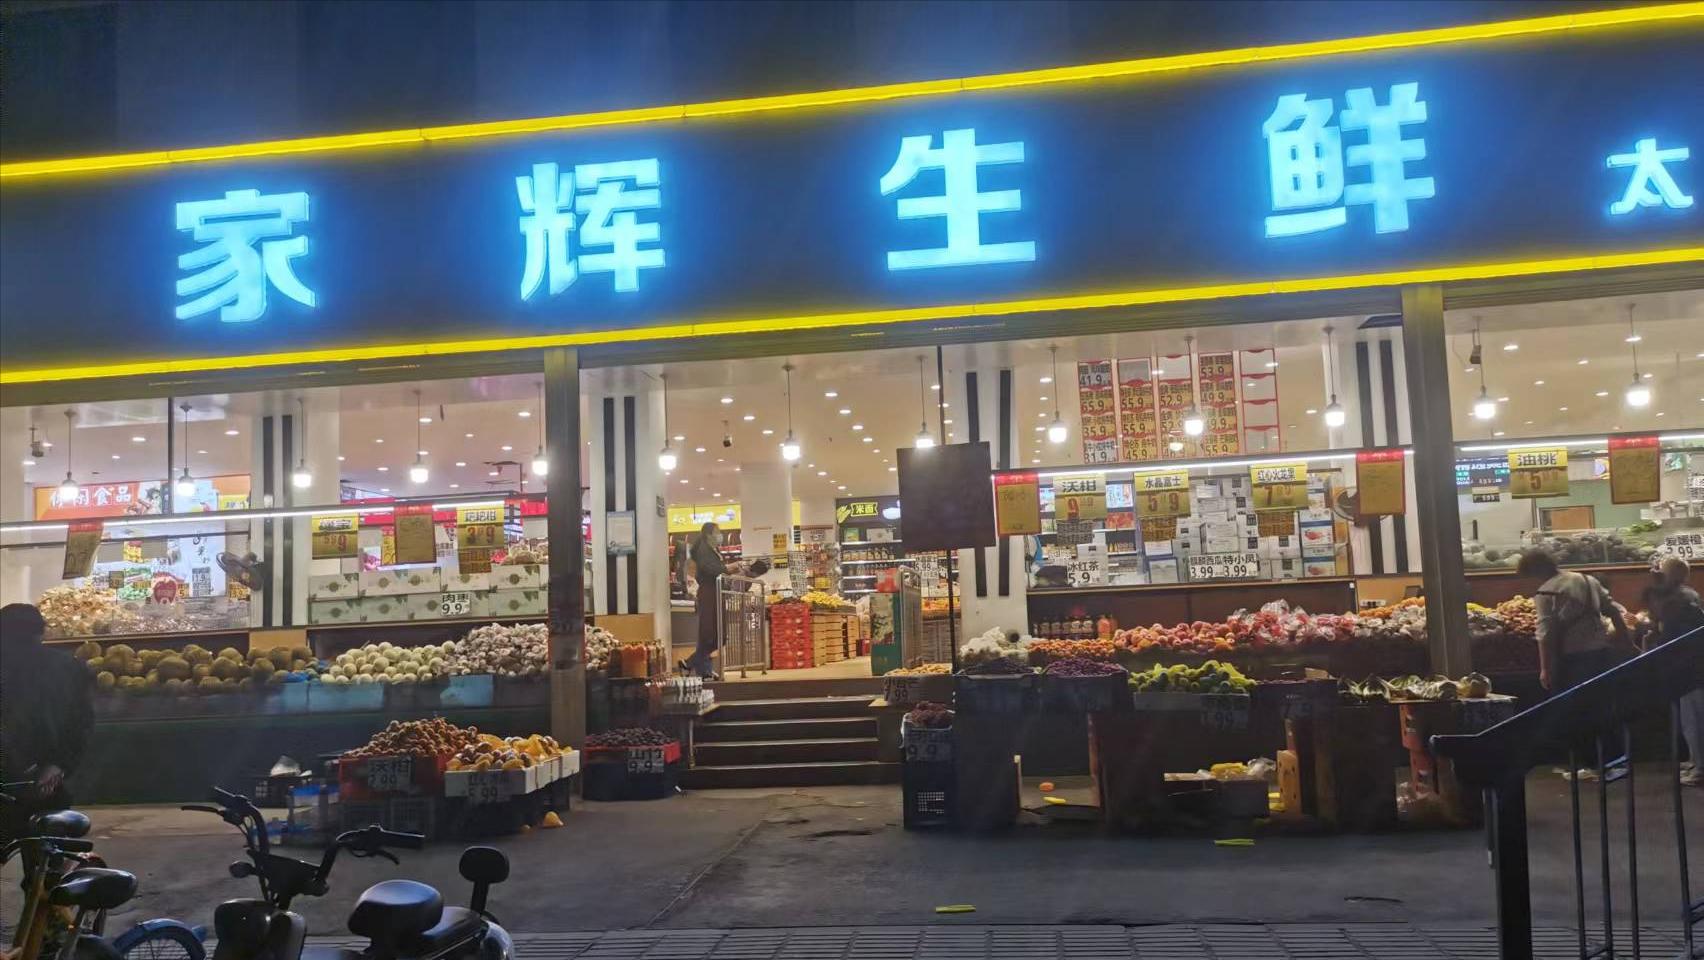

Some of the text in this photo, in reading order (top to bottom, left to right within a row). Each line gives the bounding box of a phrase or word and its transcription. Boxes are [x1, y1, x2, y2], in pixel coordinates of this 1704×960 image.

[1607, 139, 1694, 216] 太
[175, 82, 1436, 323] 家辉生鲜
[1518, 452, 1557, 466] 油桃
[1062, 480, 1097, 493] 沃柑
[1144, 475, 1182, 488] 水晶富士
[856, 503, 875, 515] 米面
[1224, 553, 1256, 564] 特小凤
[1067, 560, 1099, 572] 冰红茶
[1191, 566, 1214, 578] 3.99
[1224, 564, 1247, 577] 3.99
[1068, 572, 1091, 585] 5.9
[442, 603, 463, 615] 9.9
